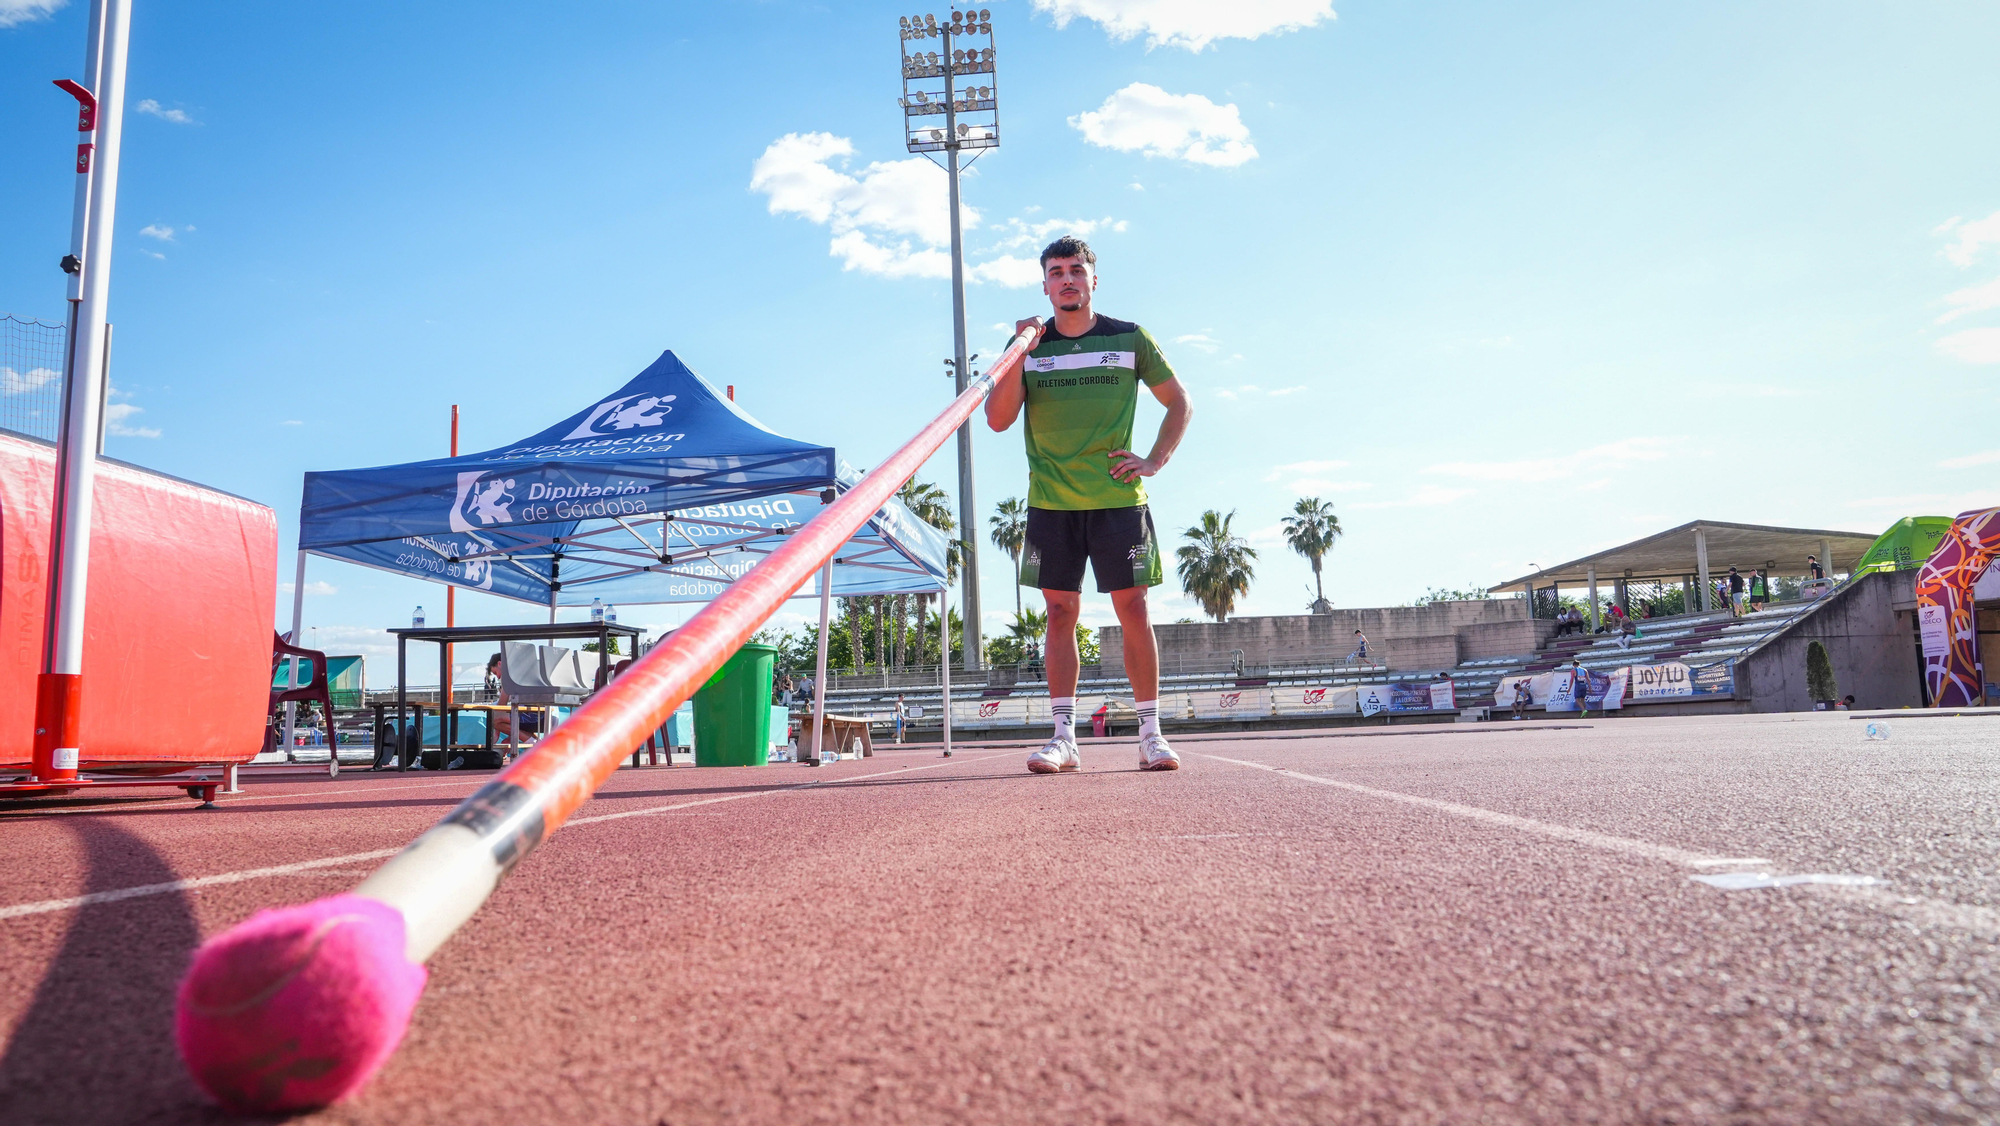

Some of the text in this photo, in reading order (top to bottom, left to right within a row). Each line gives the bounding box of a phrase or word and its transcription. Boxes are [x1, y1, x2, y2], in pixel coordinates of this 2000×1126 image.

[1037, 374, 1120, 389] ATLETISMO CORDOBÉS
[528, 480, 650, 502] Diputación
[522, 497, 648, 522] de Córdoba
